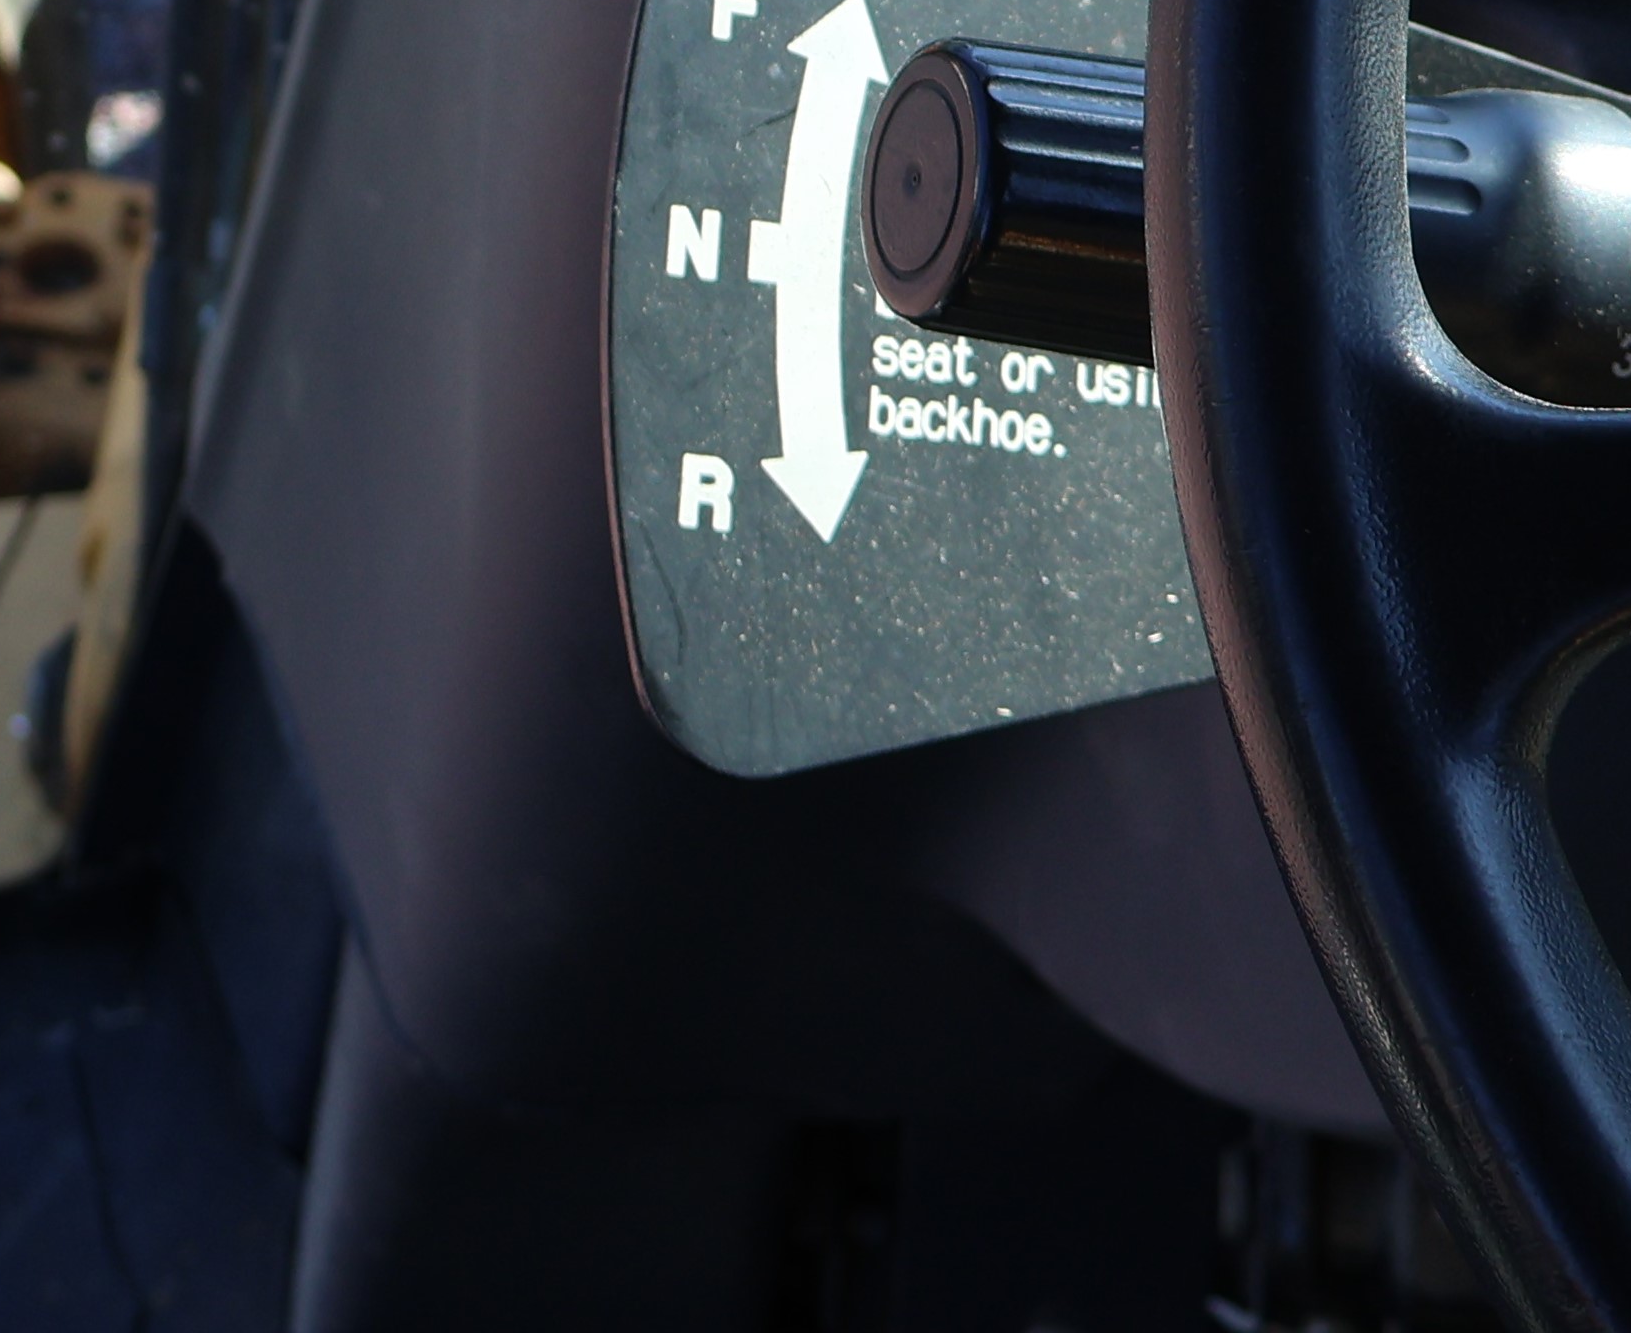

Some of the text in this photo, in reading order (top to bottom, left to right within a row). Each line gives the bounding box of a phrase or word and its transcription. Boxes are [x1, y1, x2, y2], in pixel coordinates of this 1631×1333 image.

[666, 204, 722, 282] N
[871, 334, 1162, 408] seat or usi
[868, 384, 1069, 459] backhoe.
[677, 452, 735, 534] R
